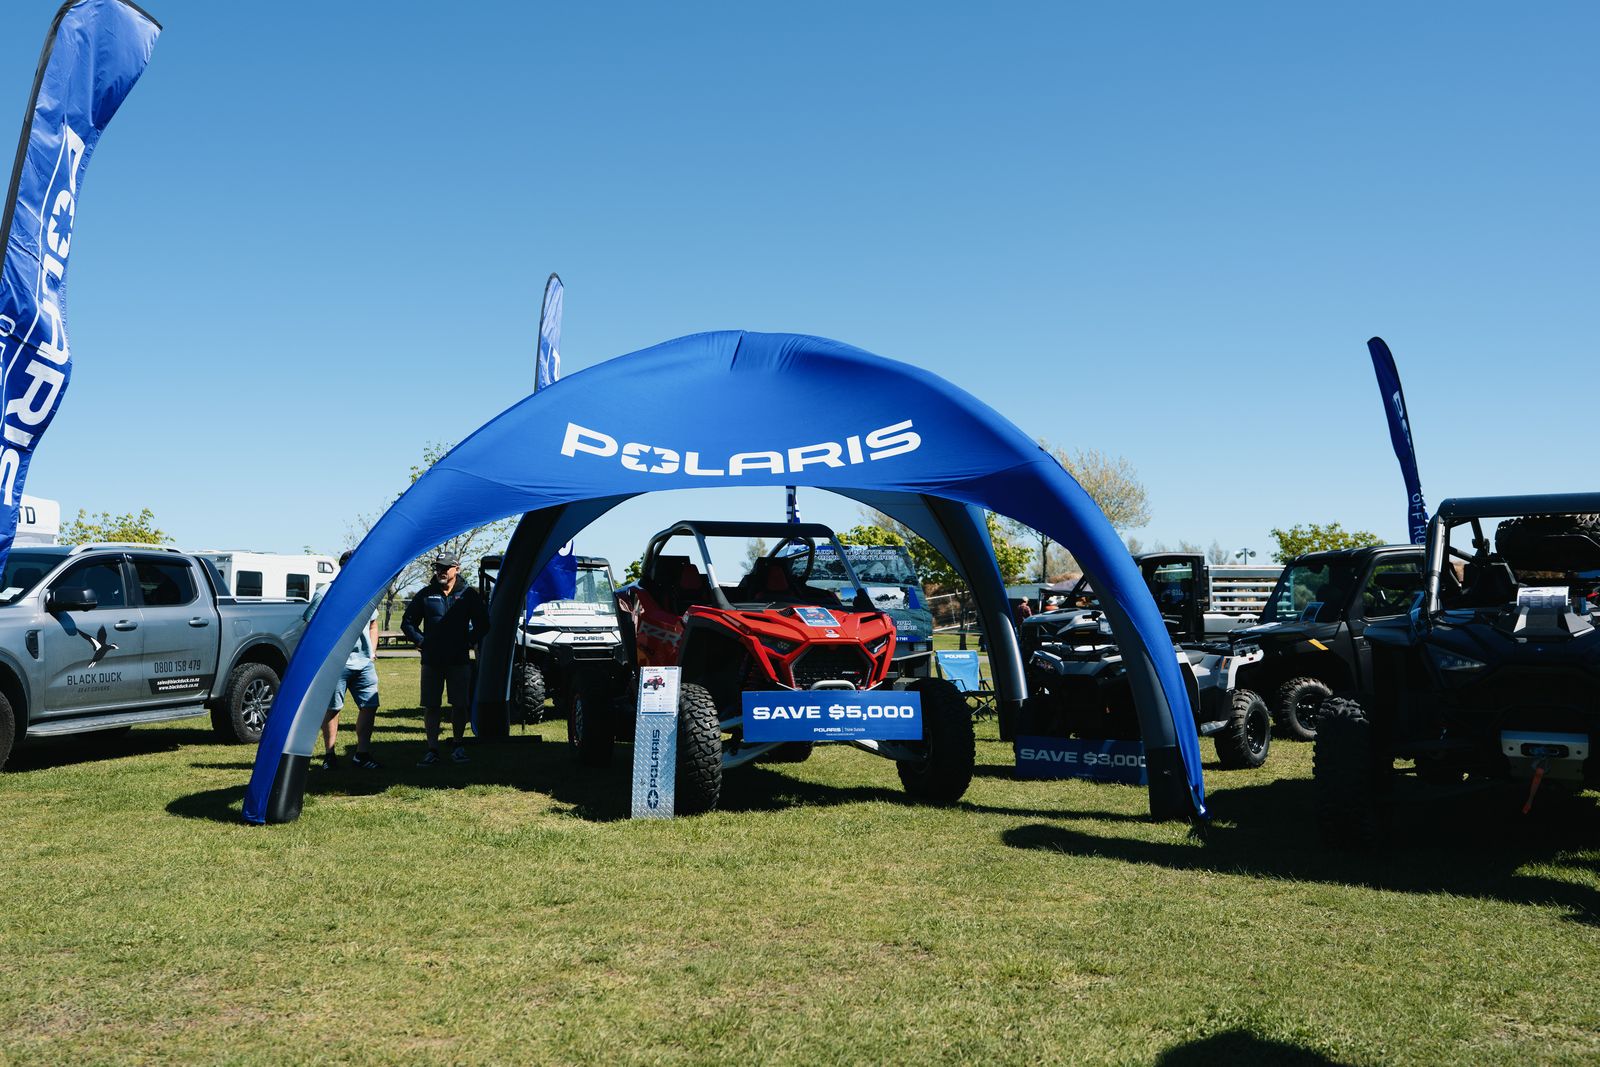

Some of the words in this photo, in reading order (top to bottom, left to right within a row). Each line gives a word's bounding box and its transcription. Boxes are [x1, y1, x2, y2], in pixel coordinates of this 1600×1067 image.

[560, 419, 922, 476] POLARIS
[1412, 493, 1424, 520] OFF
[1413, 525, 1426, 545] RO
[154, 661, 173, 674] 0800
[174, 660, 187, 672] 158
[188, 659, 201, 671] 479
[67, 673, 97, 686] BLACK
[99, 671, 122, 683] DUCK
[752, 705, 821, 720] SAVE
[828, 704, 914, 721] $5,000
[650, 729, 660, 788] POLARIS
[1020, 748, 1078, 764] SAVE
